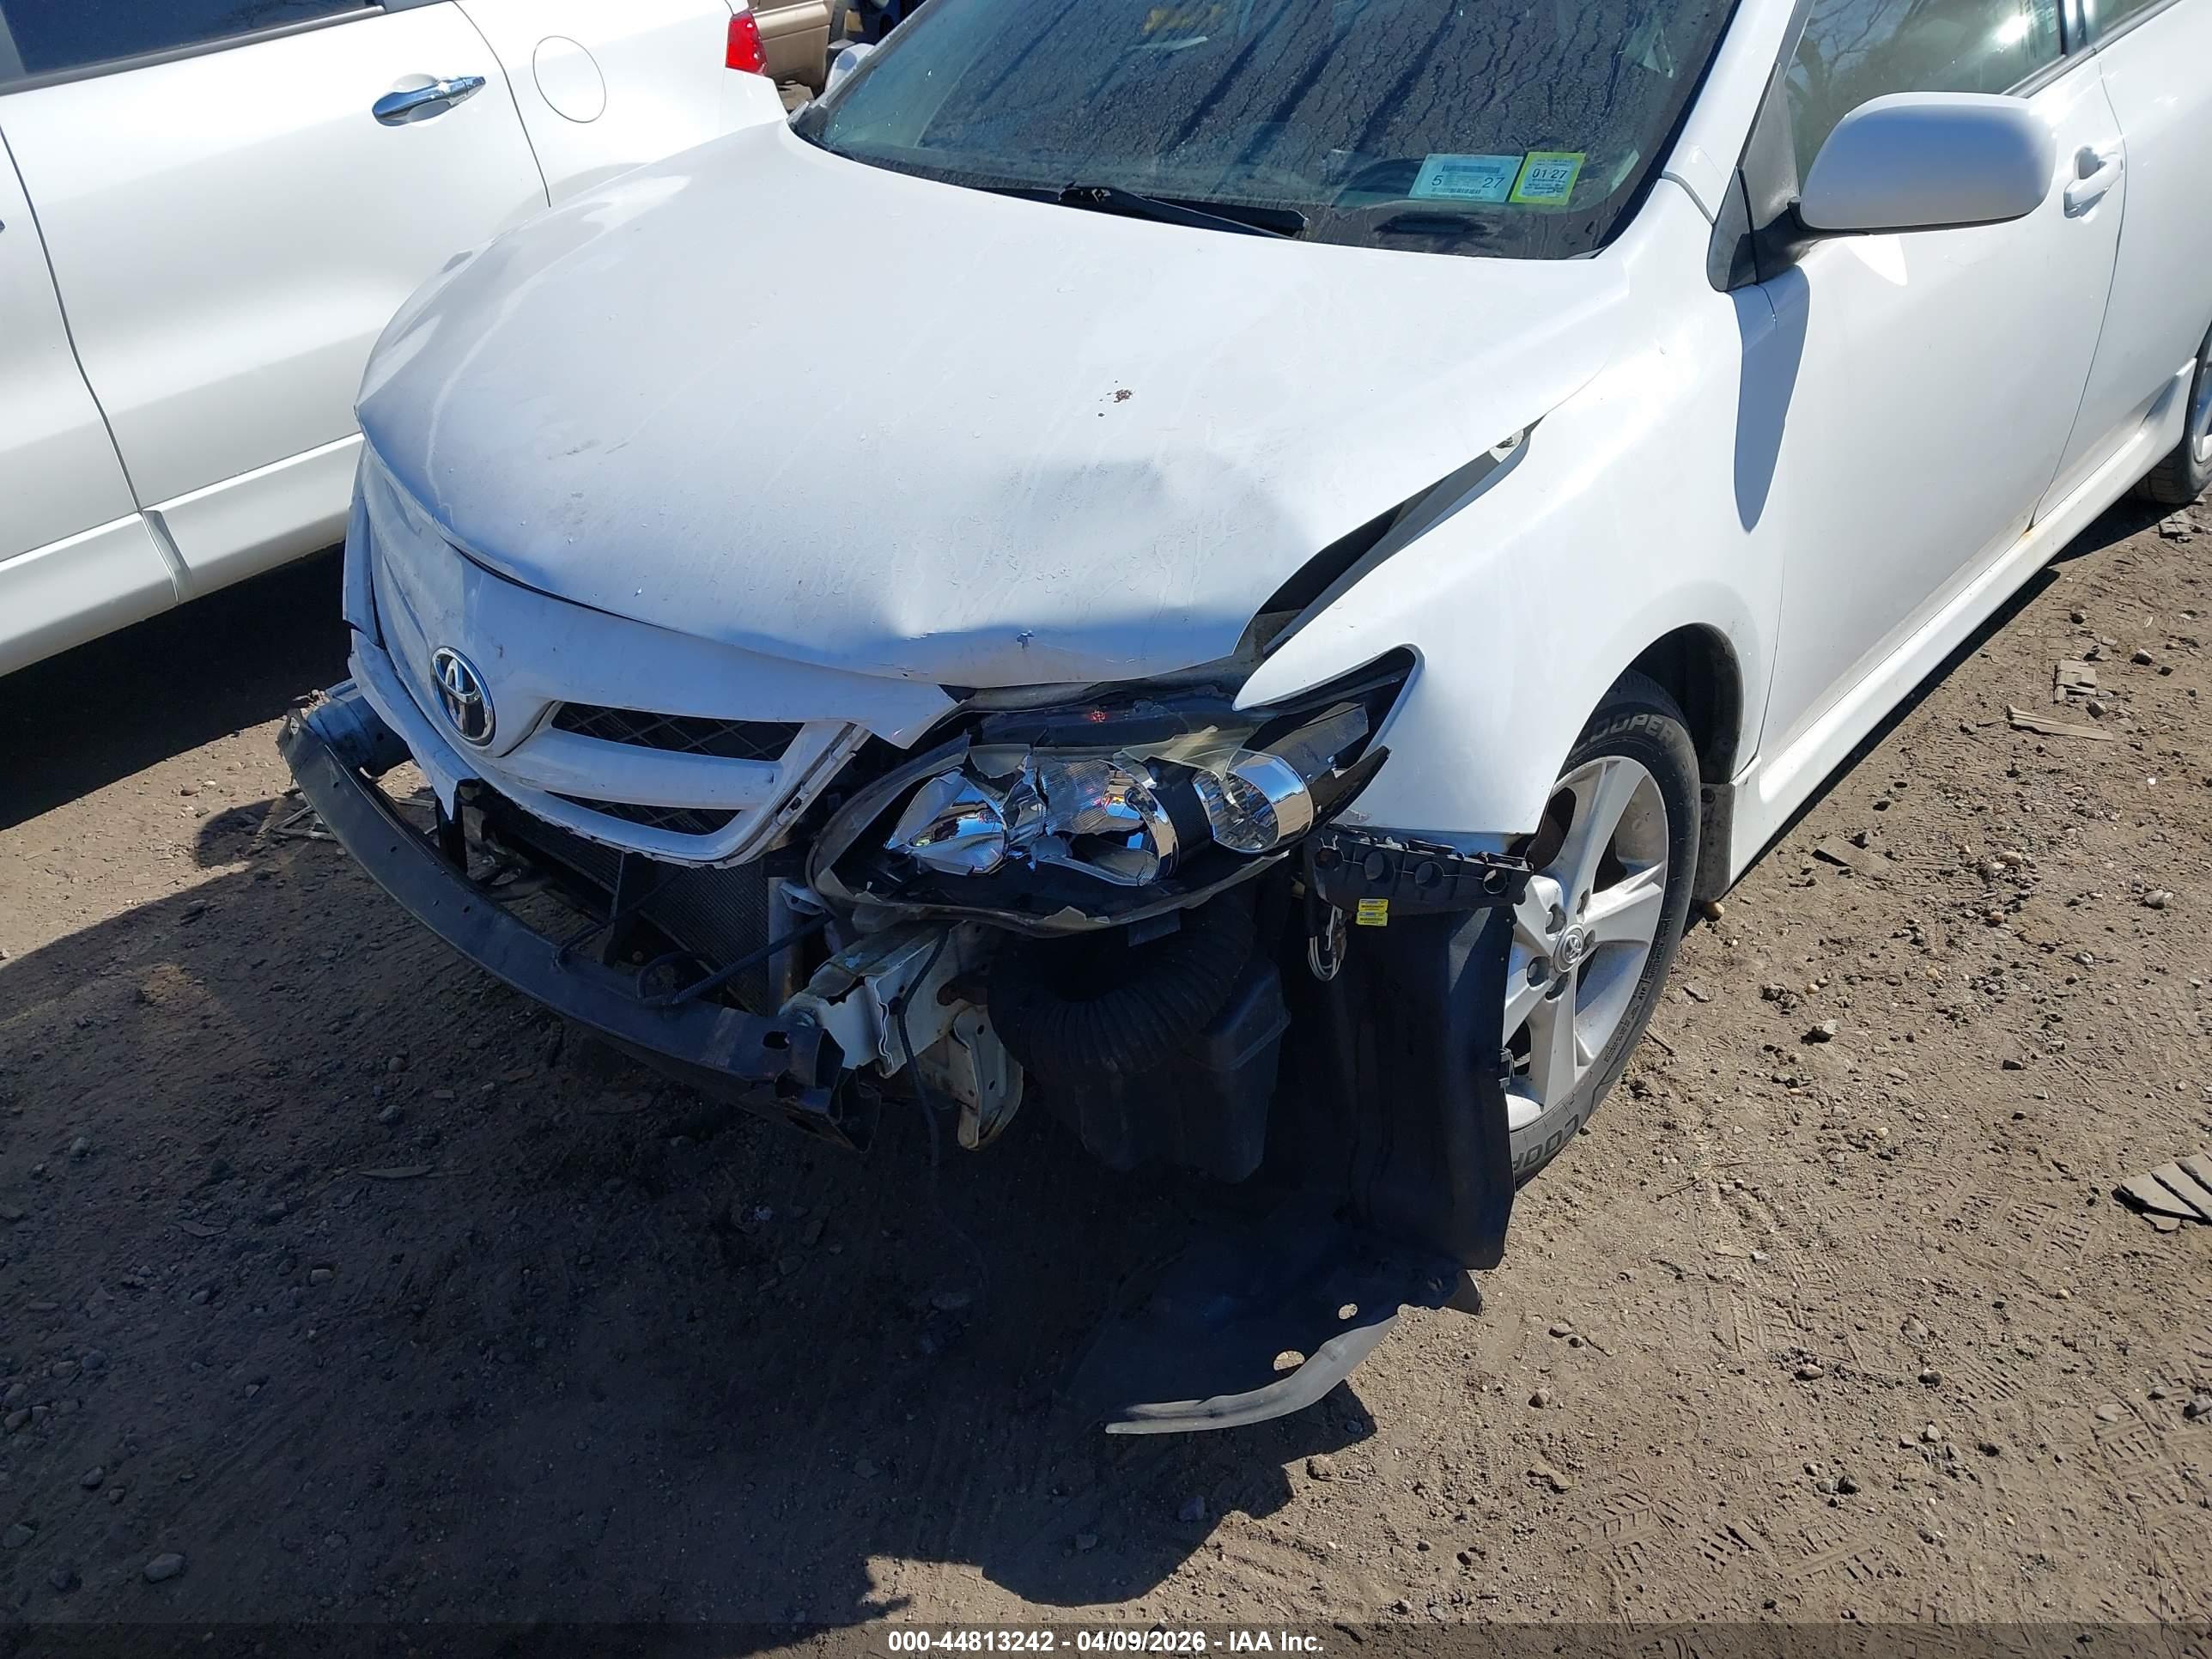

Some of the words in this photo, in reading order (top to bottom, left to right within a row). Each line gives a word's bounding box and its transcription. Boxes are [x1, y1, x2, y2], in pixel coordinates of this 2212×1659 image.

[1532, 167, 1548, 179] 01
[1550, 168, 1569, 179] 27
[1431, 174, 1443, 186] 5
[1482, 176, 1505, 189] 27
